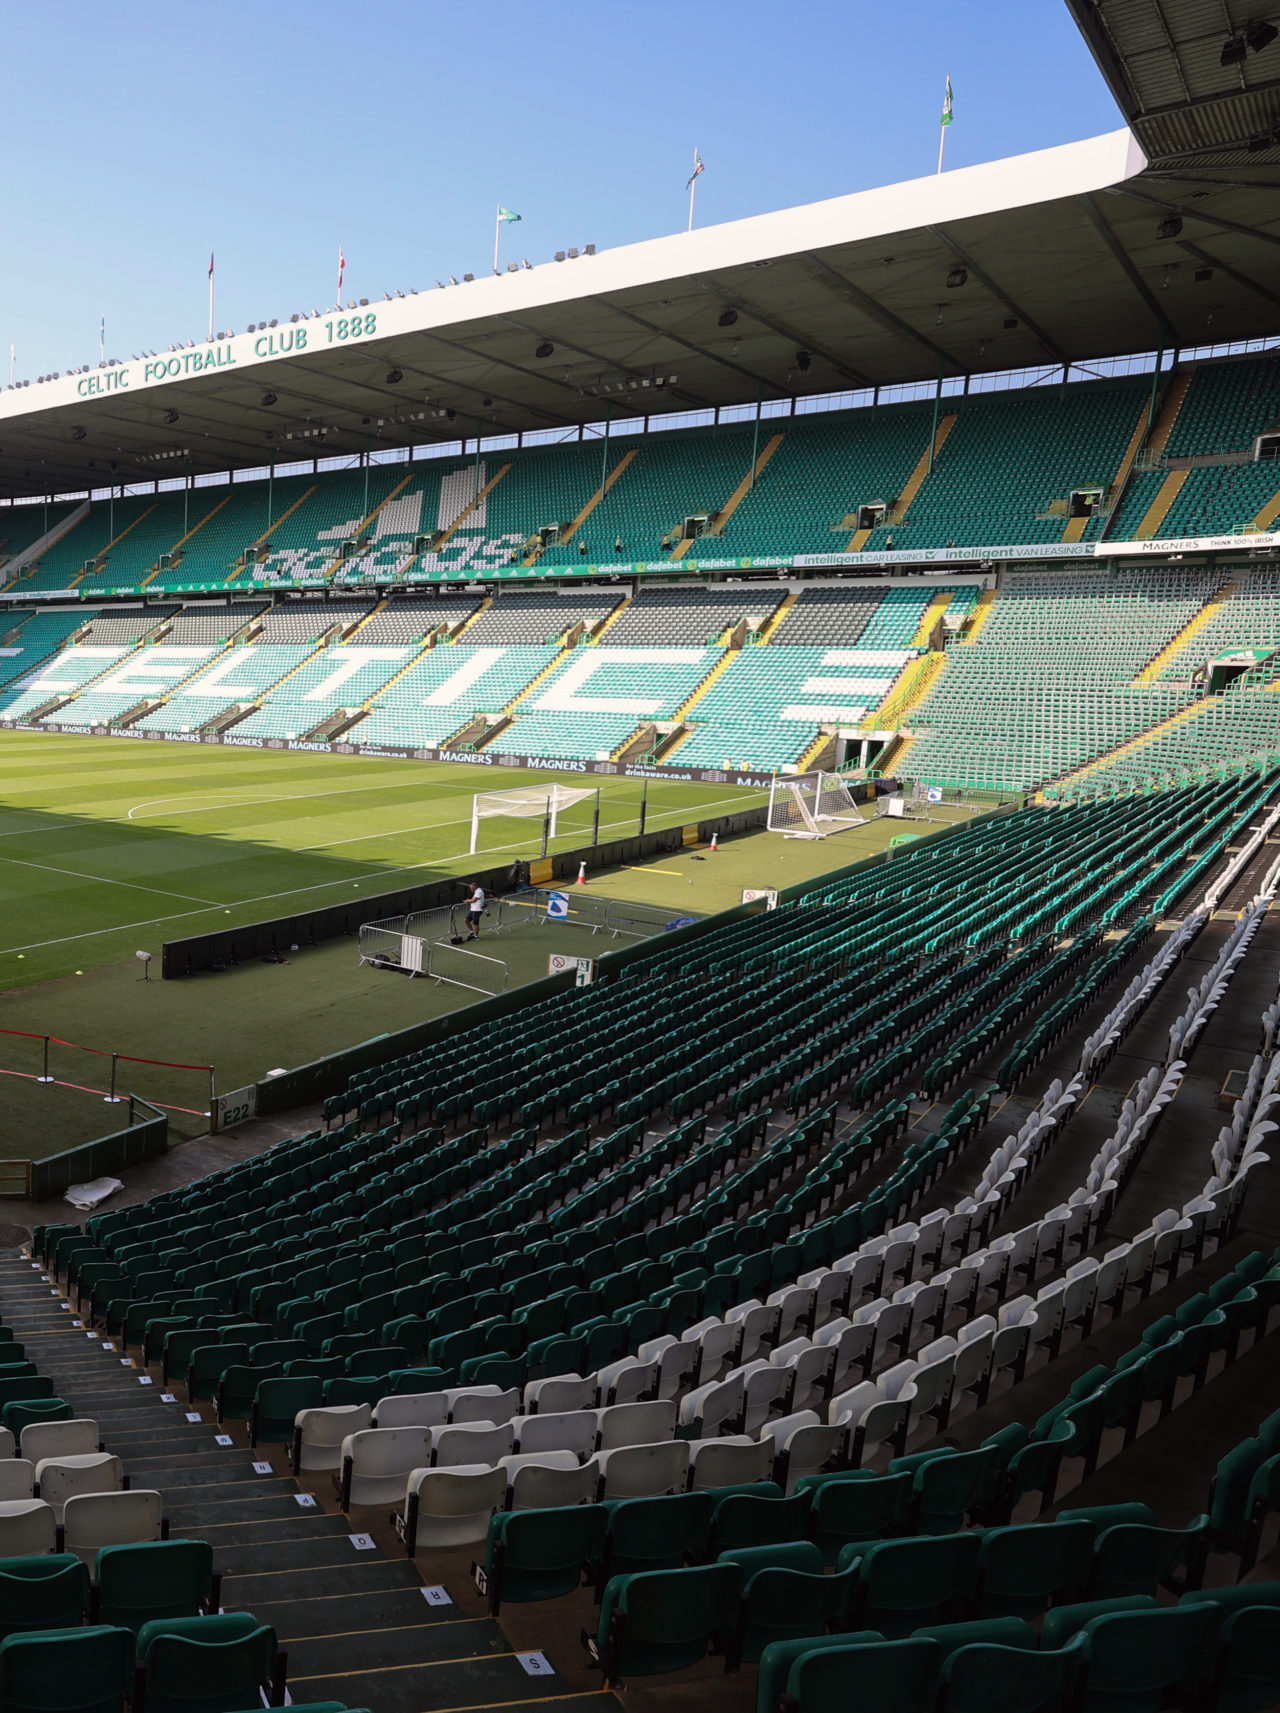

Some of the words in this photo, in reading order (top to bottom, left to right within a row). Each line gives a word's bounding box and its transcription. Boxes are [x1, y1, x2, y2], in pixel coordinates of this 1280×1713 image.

[77, 369, 129, 397] CELTIC
[144, 345, 236, 382] FOOTBALL
[254, 328, 307, 357] CLUB
[325, 313, 377, 343] 1888
[1142, 541, 1200, 551] MAGNERS
[804, 553, 865, 565] intelligent
[865, 554, 885, 563] CAR
[886, 552, 923, 562] LEASING
[945, 547, 1014, 560] intelligent
[1016, 548, 1038, 557] VAN
[1040, 546, 1083, 556] LEASING
[647, 562, 683, 571] dafabet
[698, 559, 736, 568] dafabet
[753, 557, 793, 567] dafabet
[1064, 562, 1099, 570] dafabet
[598, 564, 632, 574] dafabet
[271, 579, 293, 587] dafabet
[301, 578, 324, 586] dafabet
[146, 585, 165, 593] dafabet
[61, 724, 91, 735] MAGNERS
[110, 728, 144, 739] MAGNERS
[164, 731, 201, 743] MAGNERS
[223, 735, 263, 747] MAGNERS
[288, 740, 332, 752] MAGNERS
[358, 750, 408, 759] drinkaware.co.uk
[439, 750, 493, 765] MAGNERS
[527, 757, 587, 772] MAGNERS
[625, 768, 692, 780] drinkaware.co.uk
[223, 1103, 249, 1127] E22
[529, 1657, 541, 1669] S
